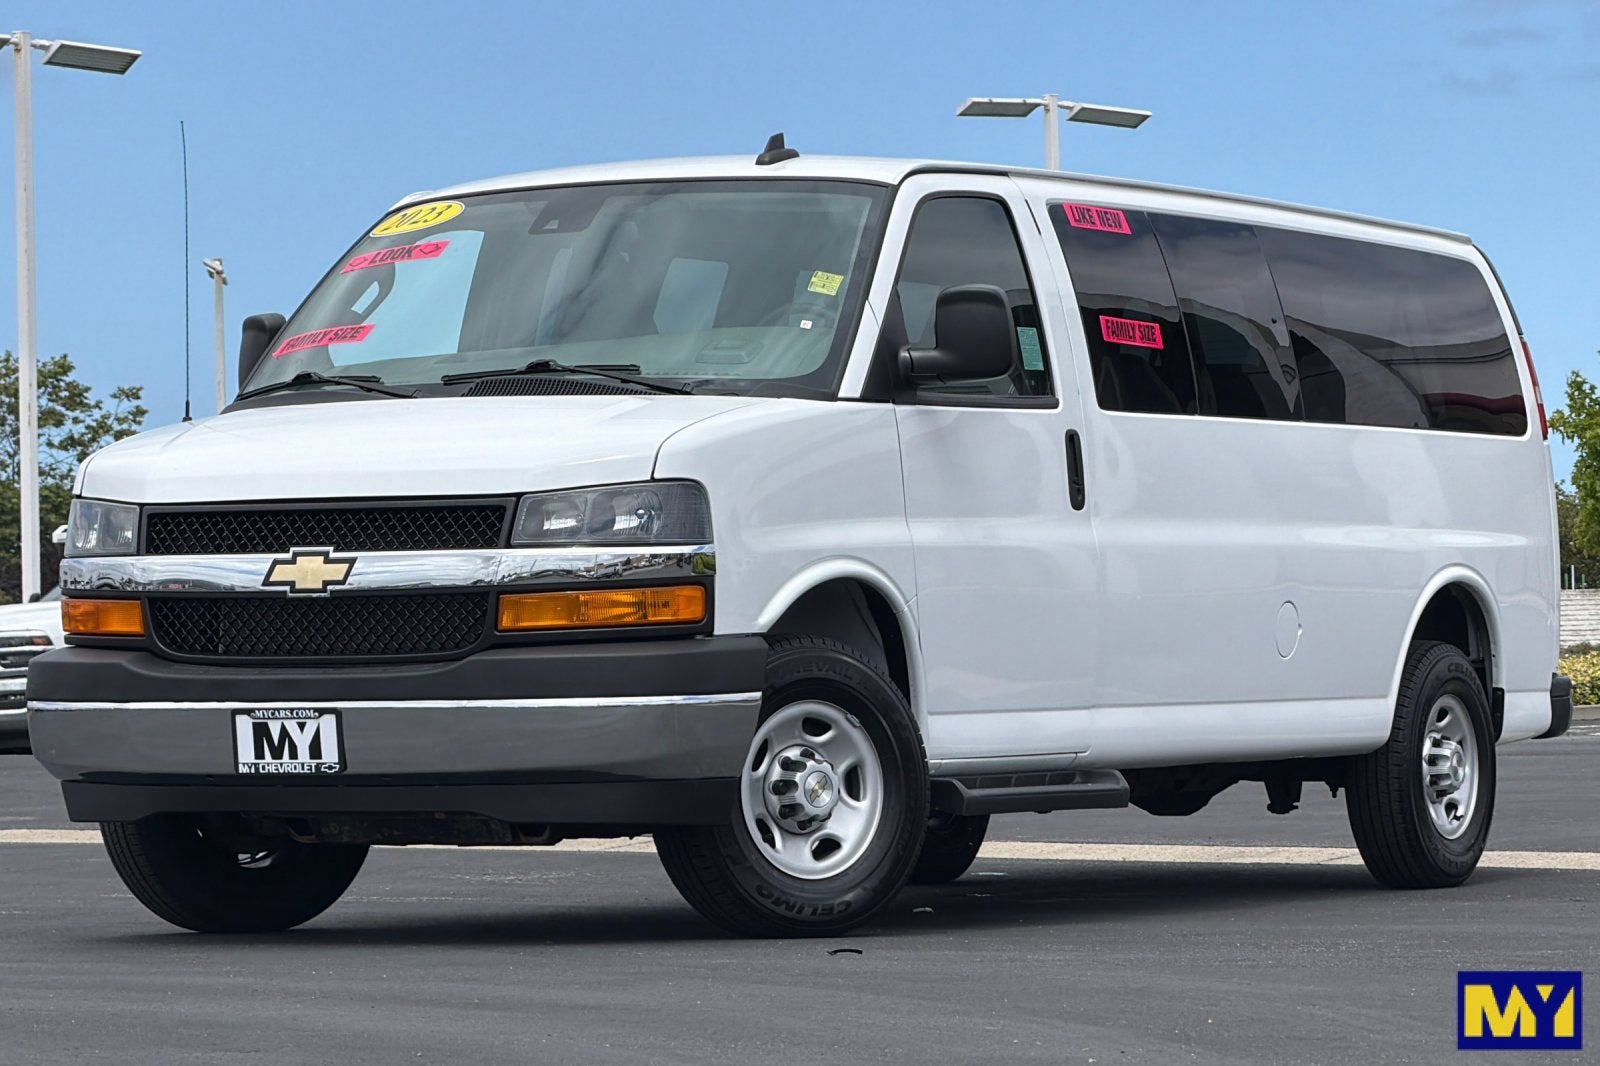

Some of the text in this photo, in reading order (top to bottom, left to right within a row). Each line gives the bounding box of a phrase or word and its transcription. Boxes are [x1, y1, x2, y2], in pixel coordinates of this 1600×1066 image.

[379, 204, 453, 233] 2023
[1069, 205, 1123, 229] LIKE NEW
[367, 244, 421, 265] LOOK
[282, 325, 367, 352] FAMILY SIZE
[1104, 318, 1158, 343] FAMILY SIZE
[253, 709, 315, 719] MYCARS.COM
[252, 721, 323, 760] MY
[239, 763, 317, 774] MY CHEVROLET
[755, 884, 853, 917] CELIMO
